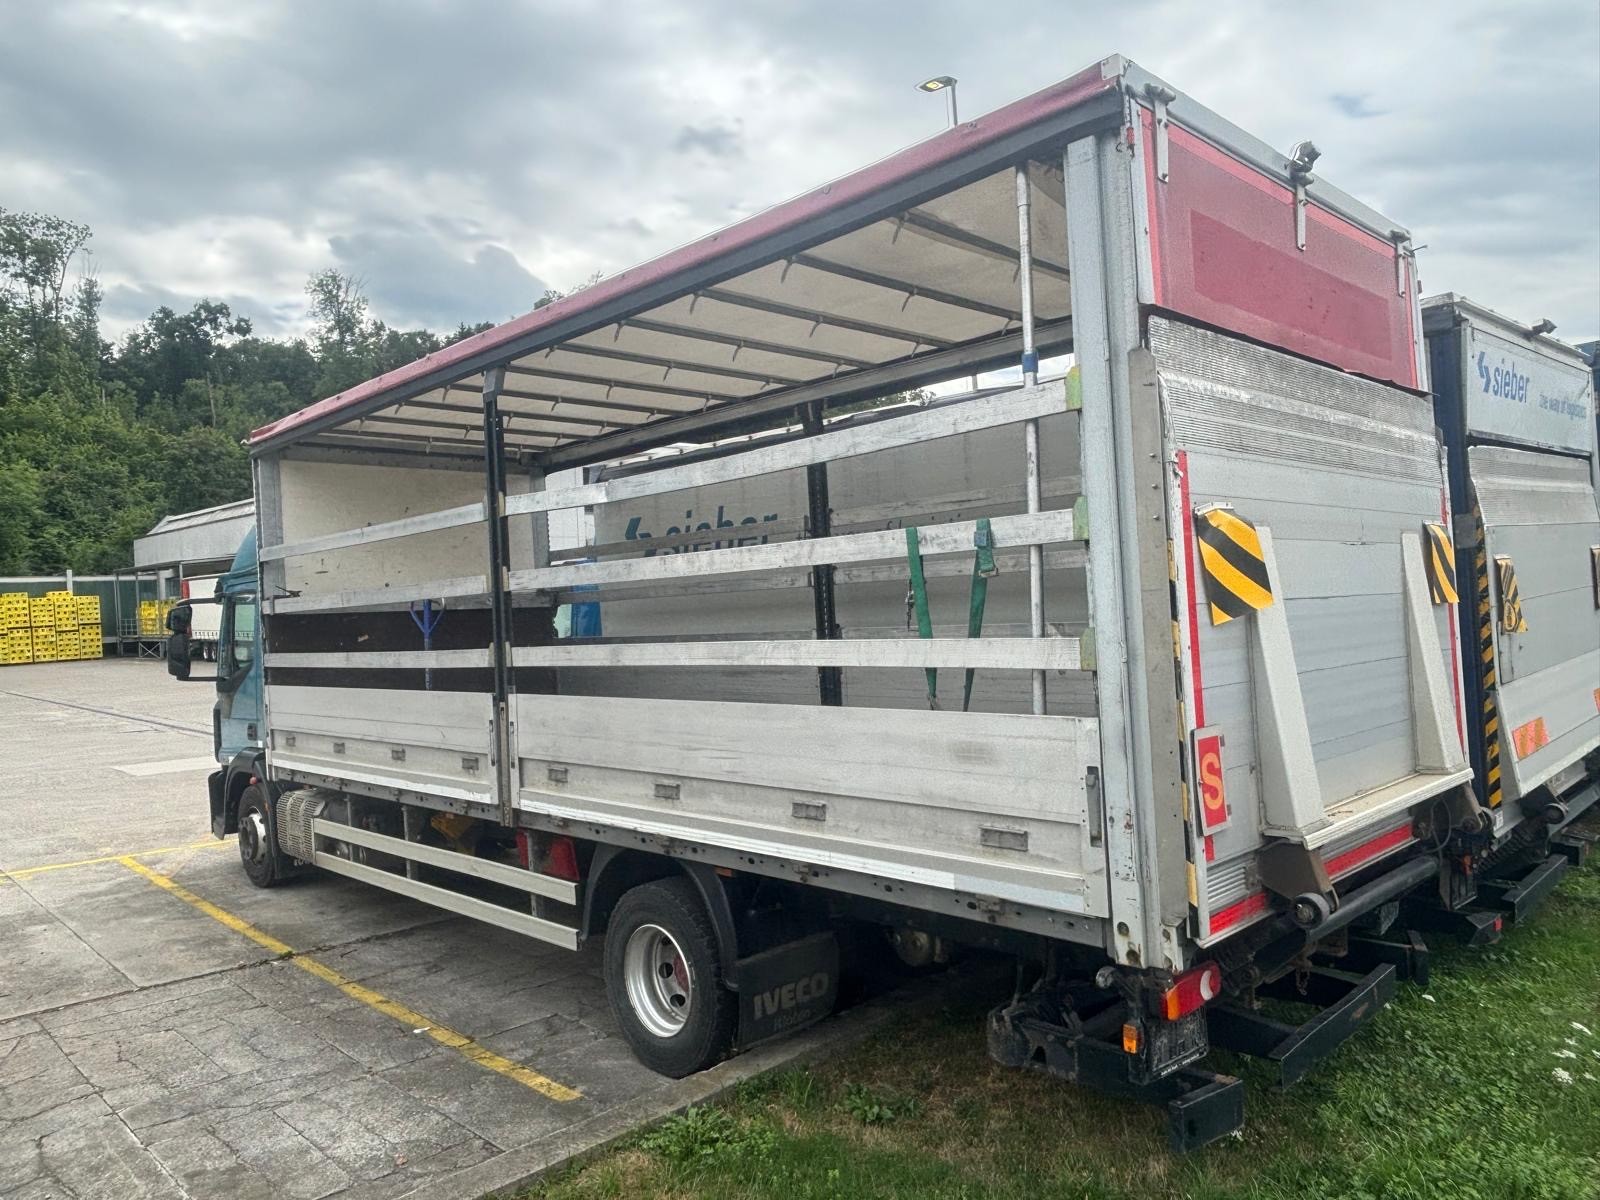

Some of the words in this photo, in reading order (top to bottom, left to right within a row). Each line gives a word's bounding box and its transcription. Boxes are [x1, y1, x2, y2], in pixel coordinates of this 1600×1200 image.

[1493, 357, 1530, 404] sieber
[1201, 752, 1224, 810] S
[753, 972, 829, 1020] IVECO
